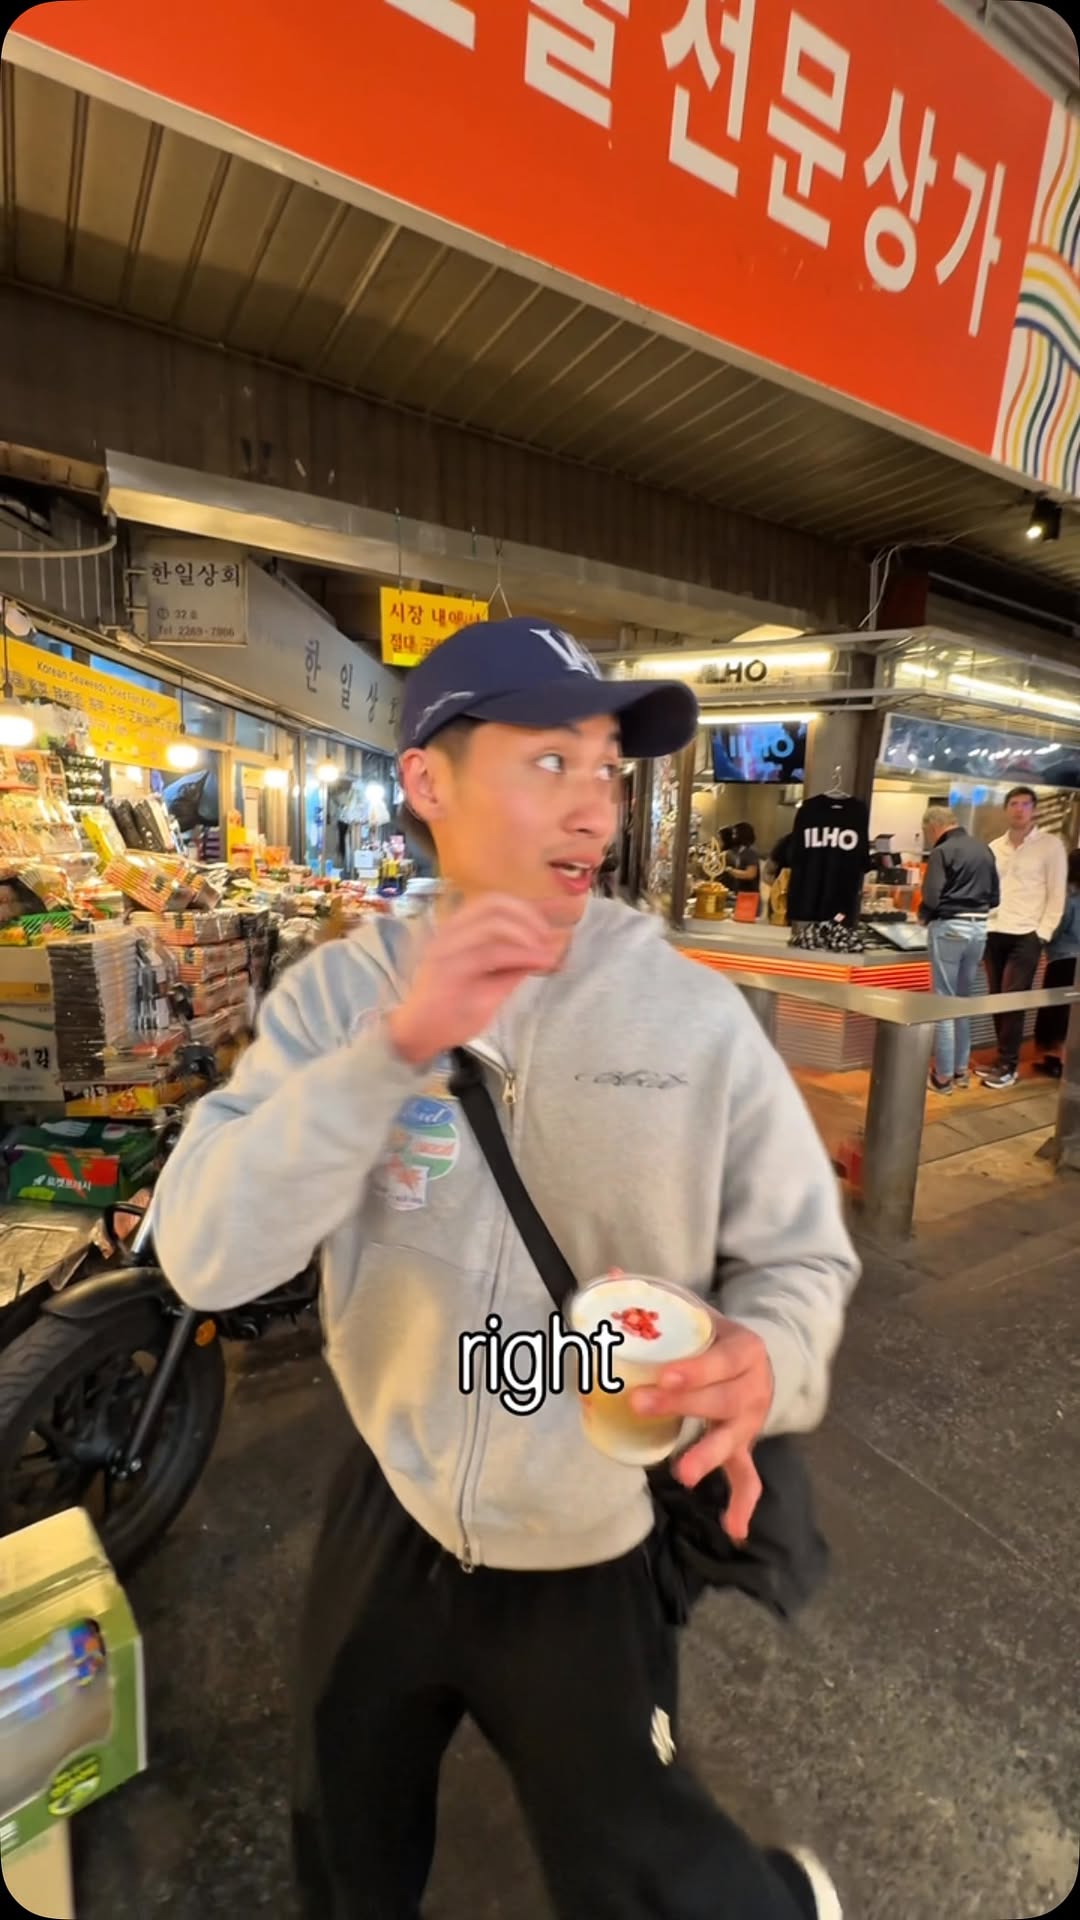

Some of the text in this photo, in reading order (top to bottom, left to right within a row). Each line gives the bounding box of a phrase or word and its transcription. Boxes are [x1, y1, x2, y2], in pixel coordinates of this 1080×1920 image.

[150, 561, 241, 588] 한일상회
[390, 602, 424, 626] 시장
[390, 633, 417, 654] 절대
[37, 660, 69, 680] Korean
[804, 827, 859, 852] ILHO
